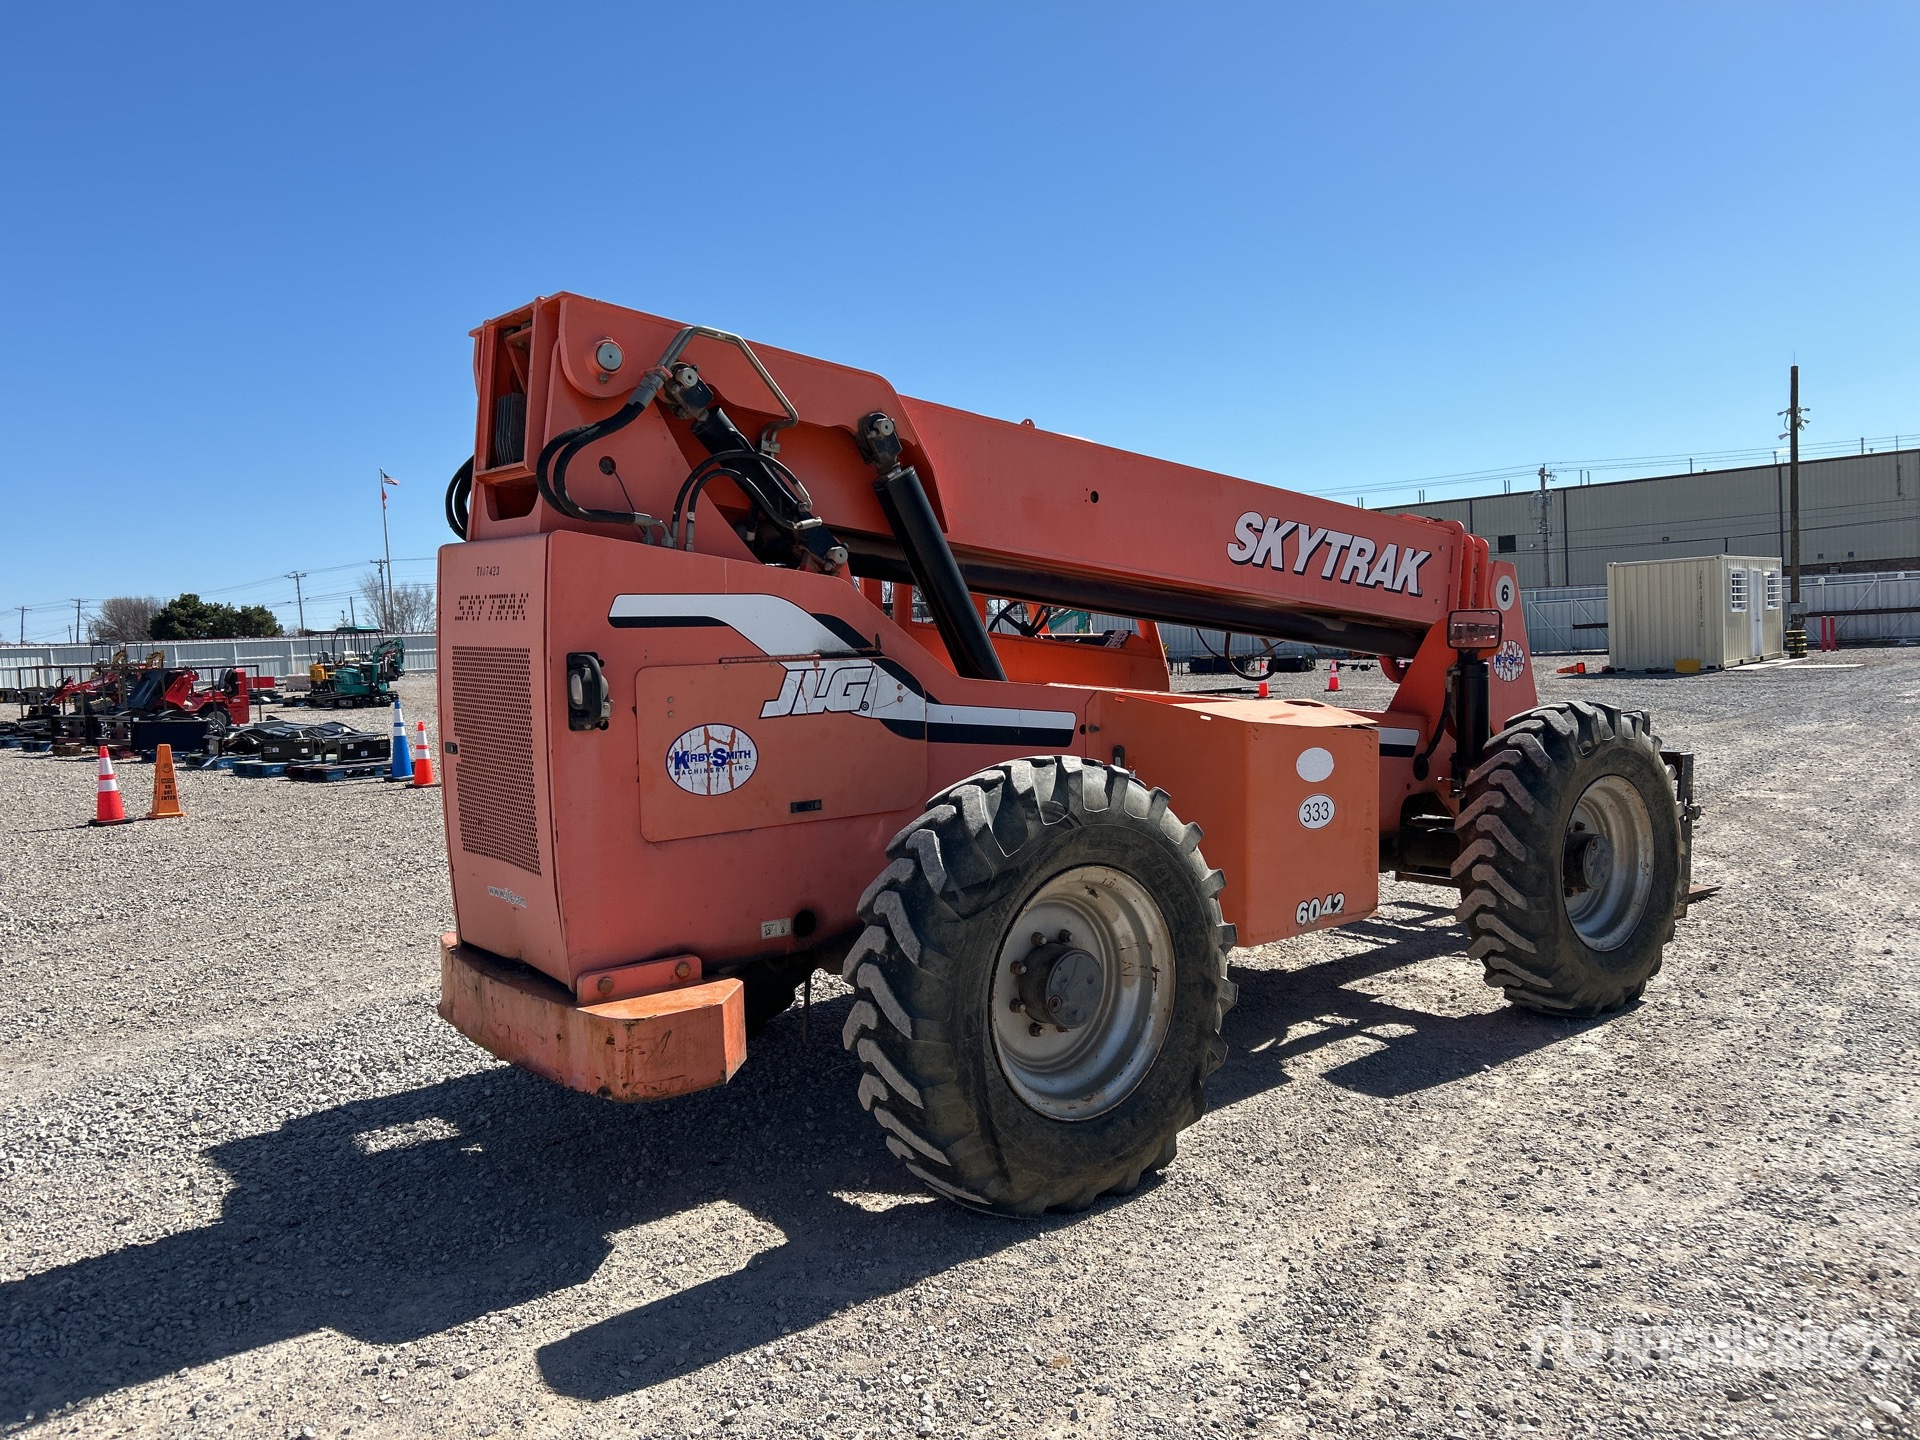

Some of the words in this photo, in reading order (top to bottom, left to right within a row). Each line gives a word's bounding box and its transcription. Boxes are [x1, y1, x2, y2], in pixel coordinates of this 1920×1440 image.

[1227, 511, 1432, 597] SKYTRAK
[455, 593, 529, 621] SKYTRAK
[1501, 584, 1509, 602] 6
[759, 668, 875, 719] JLG
[674, 748, 751, 770] KIRBY-SMITH
[1303, 802, 1329, 823] 333
[1295, 892, 1345, 926] 6042
